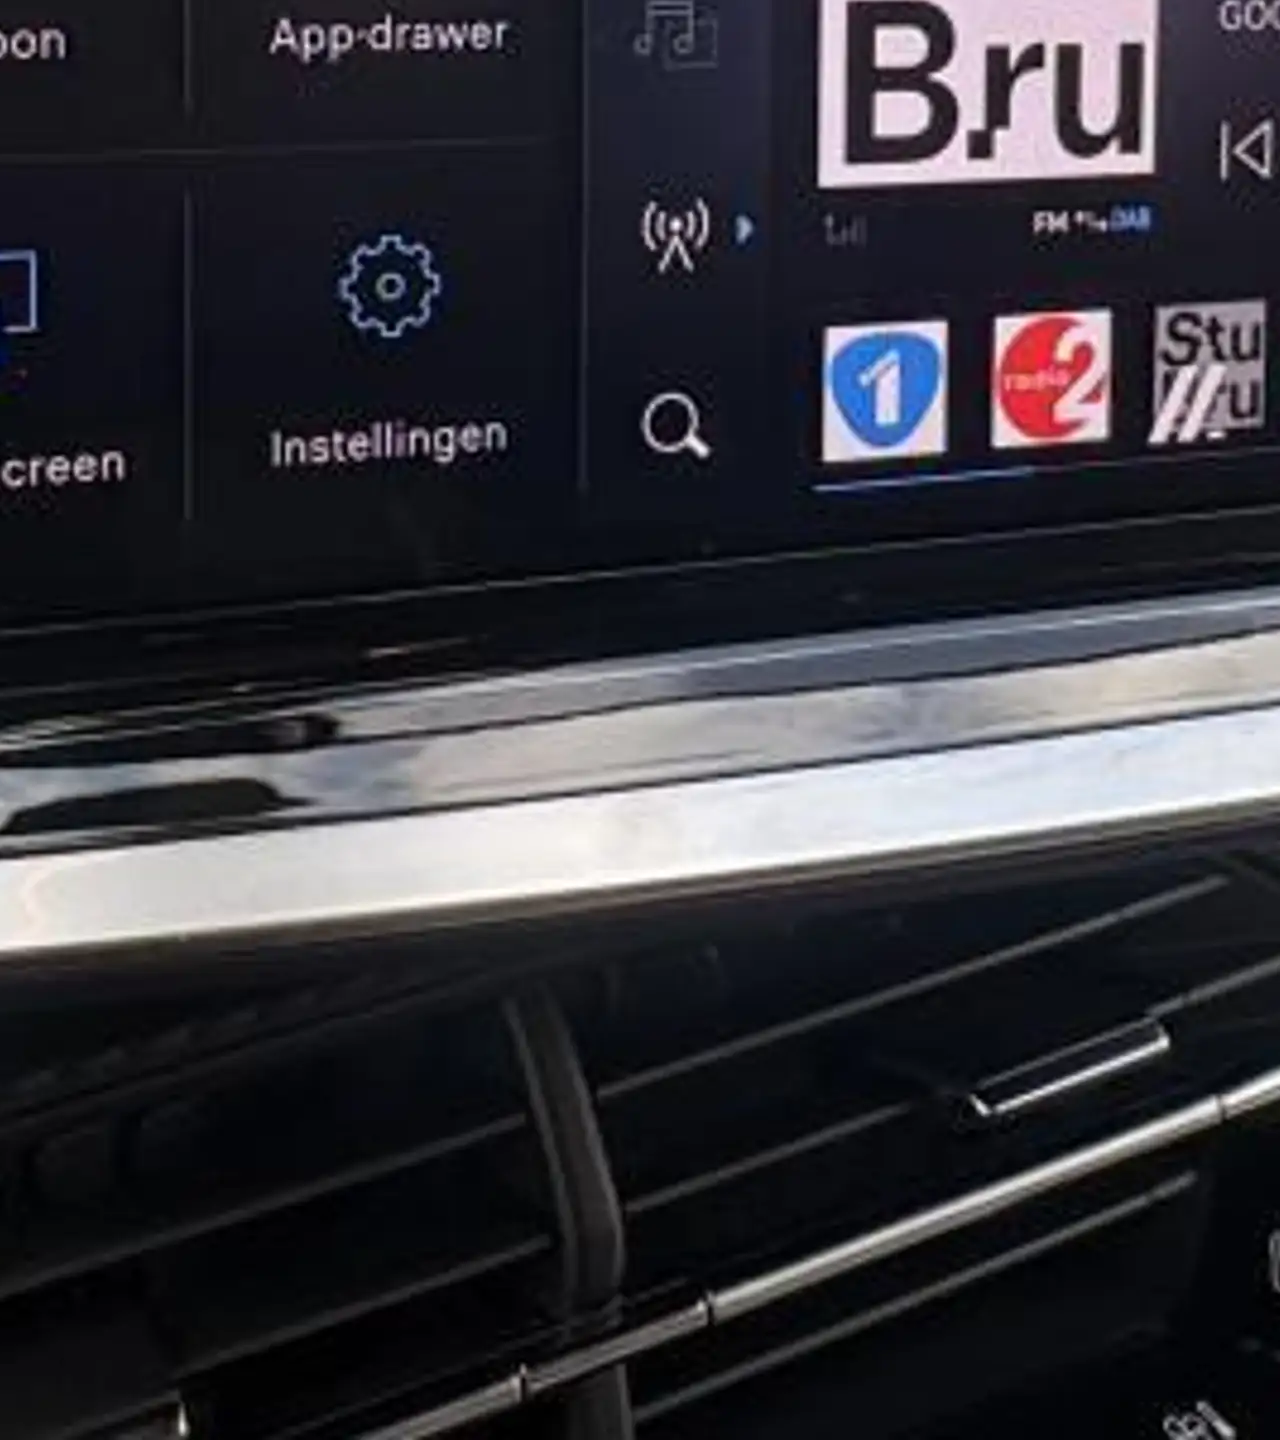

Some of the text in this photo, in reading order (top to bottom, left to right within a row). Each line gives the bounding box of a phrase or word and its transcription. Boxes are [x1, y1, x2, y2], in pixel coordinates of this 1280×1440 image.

[844, 0, 1145, 164] Bru
[1032, 210, 1070, 233] FM
[1161, 311, 1261, 366] Stu
[271, 419, 509, 467] Instellingen
